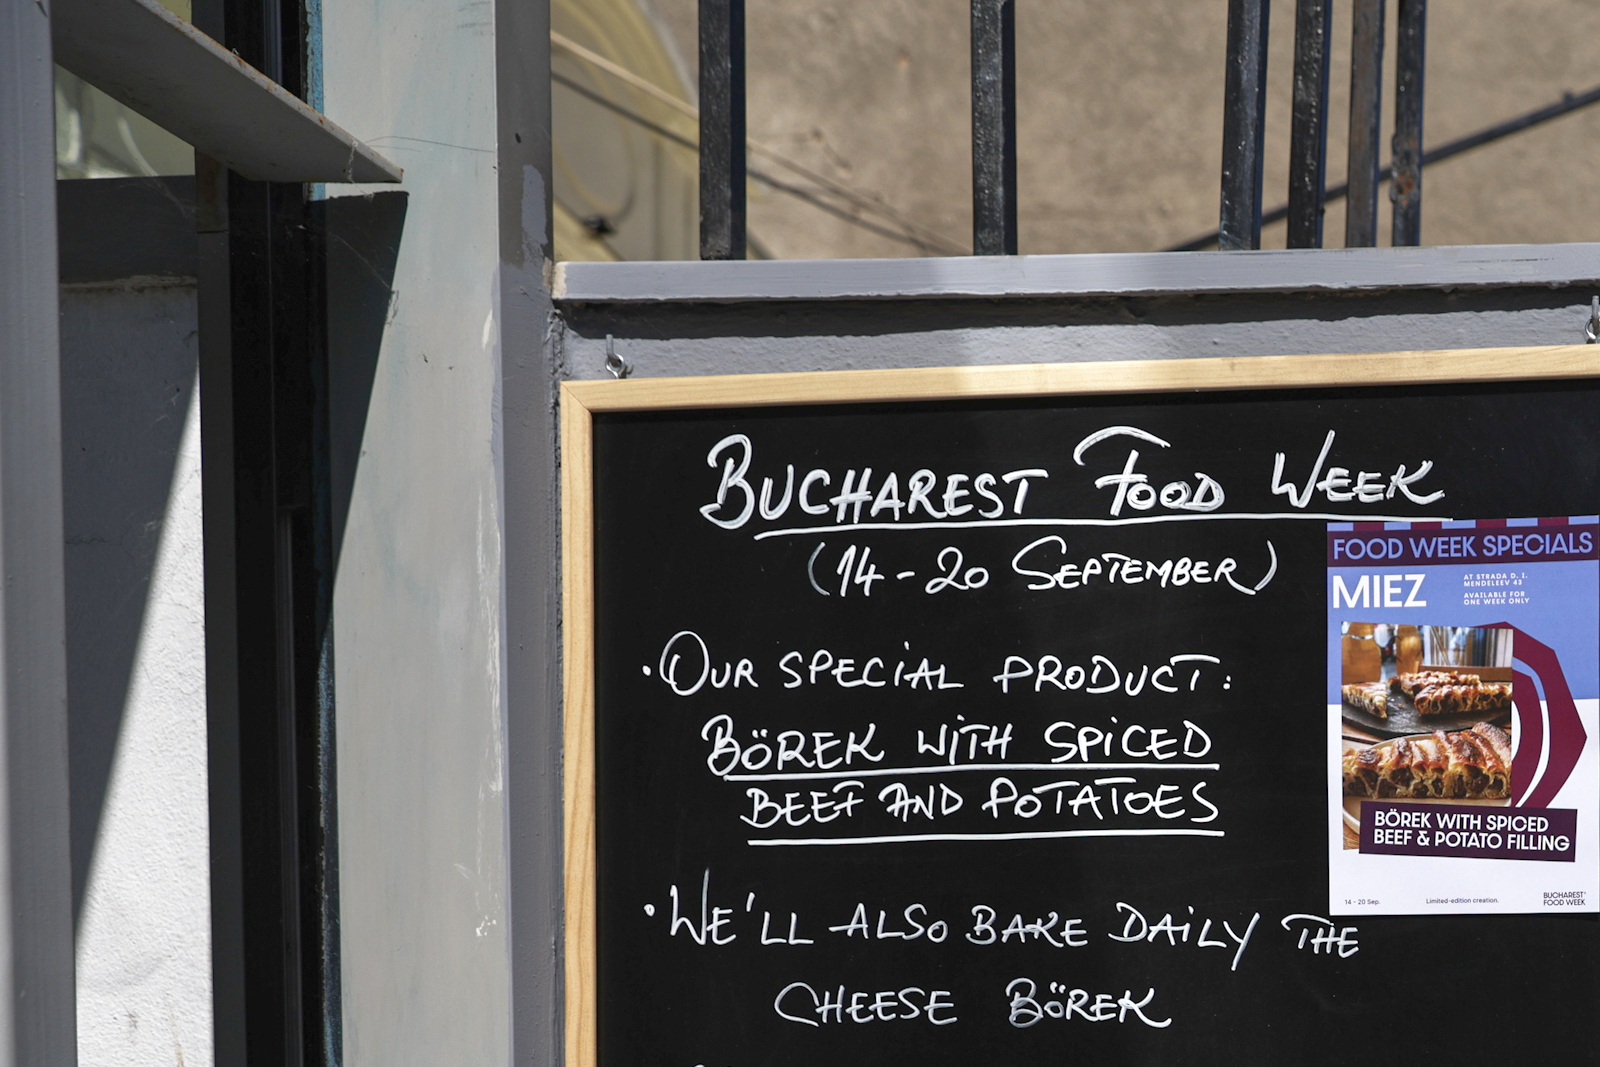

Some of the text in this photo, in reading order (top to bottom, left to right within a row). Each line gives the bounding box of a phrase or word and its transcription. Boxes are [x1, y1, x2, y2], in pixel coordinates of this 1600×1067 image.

[700, 425, 1446, 530] BUCHAREST FOOD WEEK
[1333, 531, 1594, 560] FOOD WEEK SPECIALS
[1463, 578, 1523, 587] MENDELEEV 43
[1476, 572, 1508, 580] STRADA
[1332, 573, 1427, 609] MIEZ
[1463, 591, 1507, 599] AVAILABLE
[1463, 598, 1481, 606] ONE
[659, 630, 759, 697] OUR
[739, 776, 1220, 829] BEEF AND POTATOES
[1374, 808, 1549, 833] BÖREK WITH SPICED
[1373, 828, 1571, 852] BEEF & POTATO FILLING
[829, 903, 949, 943] ALSO
[965, 904, 1088, 947] BAKE
[1281, 913, 1360, 958] THE
[774, 977, 1173, 1028] CHEESE BÖREK
